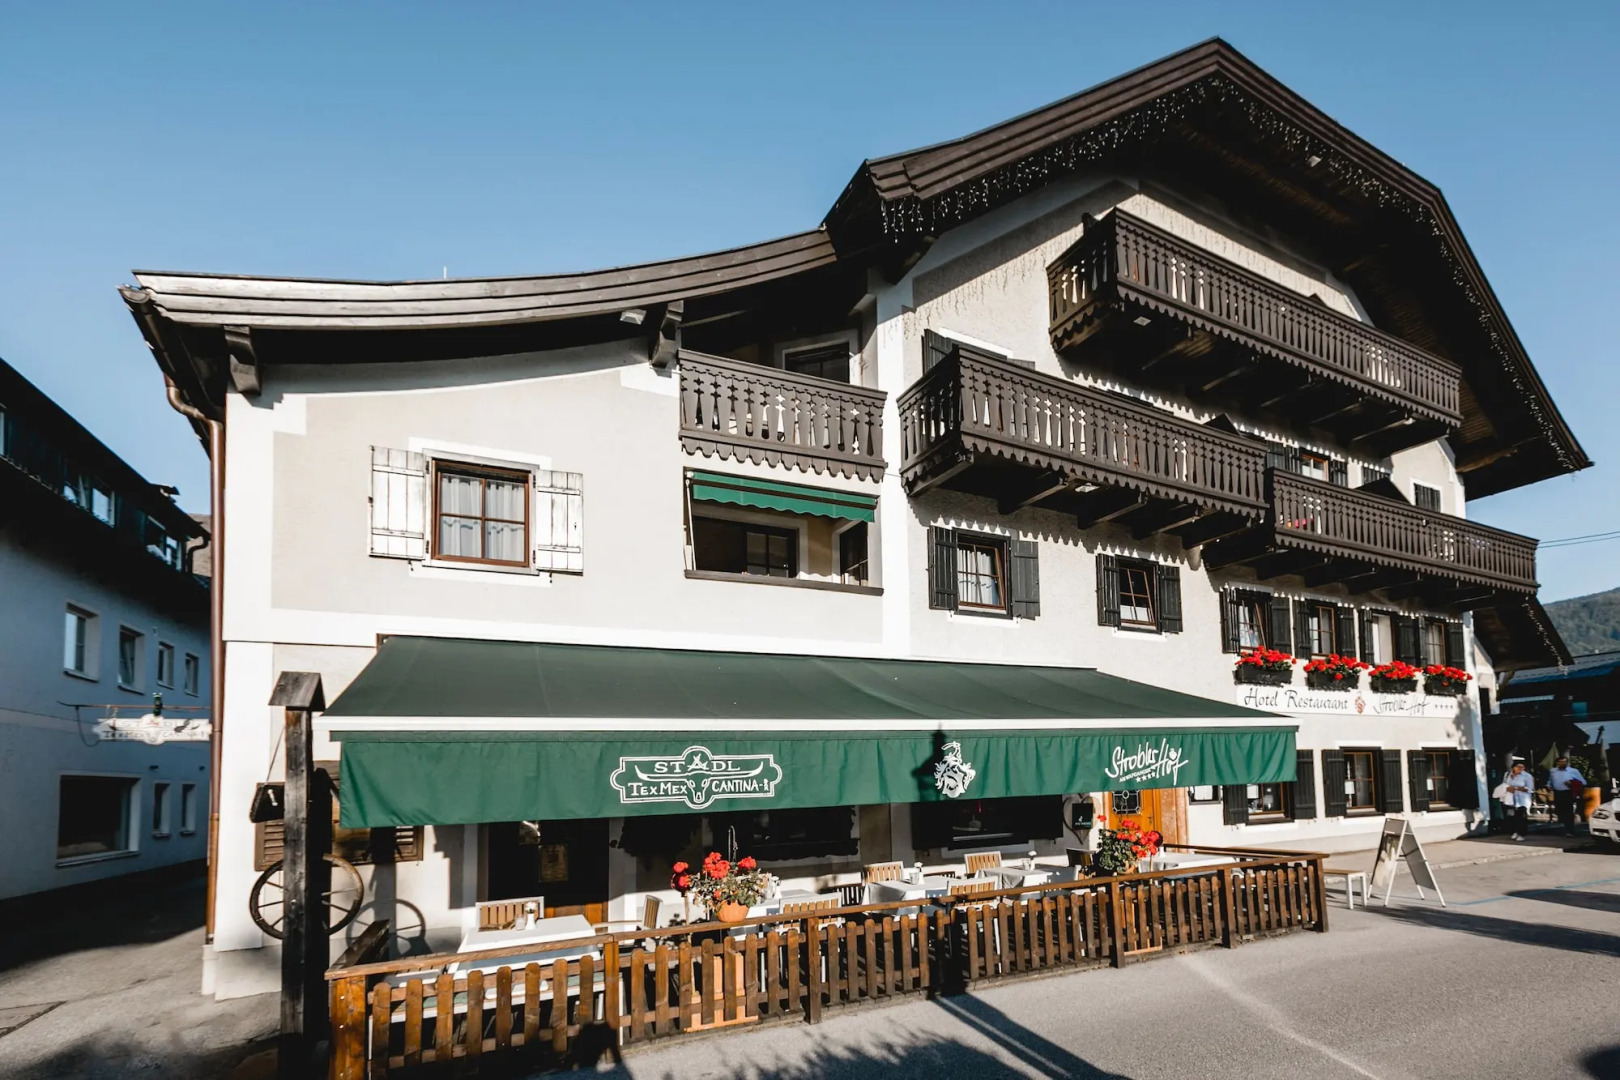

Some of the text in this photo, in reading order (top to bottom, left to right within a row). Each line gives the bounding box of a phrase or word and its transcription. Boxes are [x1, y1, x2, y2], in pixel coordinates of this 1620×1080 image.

[1243, 687, 1279, 708] Hotel
[1284, 689, 1348, 710] Restaurant
[653, 753, 741, 773] STADL
[1152, 737, 1189, 786] Hof
